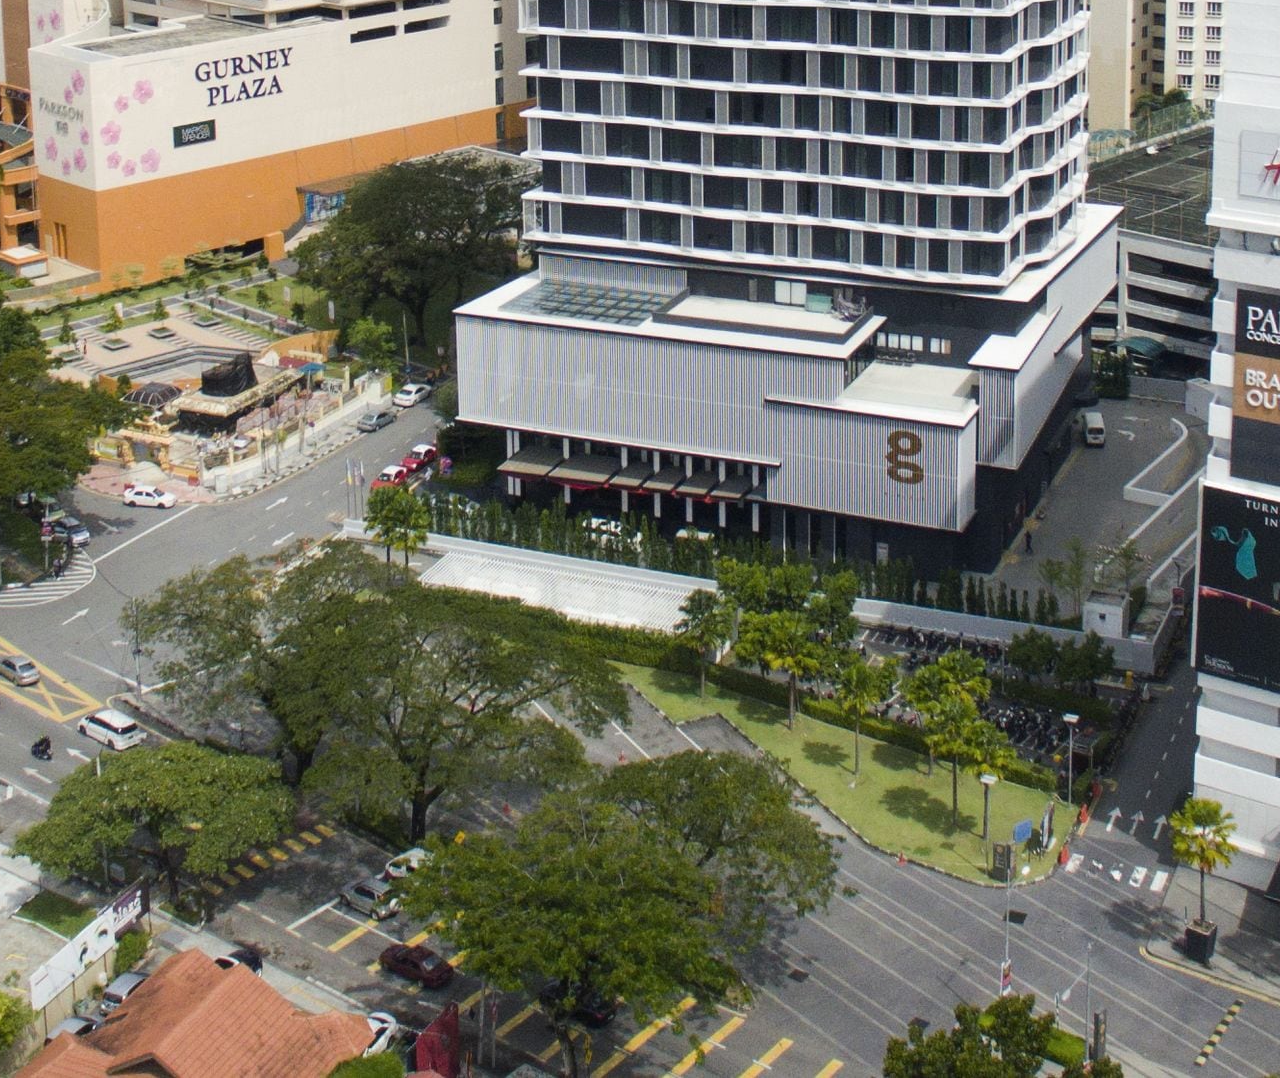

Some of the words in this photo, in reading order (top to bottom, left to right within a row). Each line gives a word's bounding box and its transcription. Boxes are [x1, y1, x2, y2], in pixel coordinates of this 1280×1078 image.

[194, 47, 293, 82] GURNEY
[207, 75, 283, 107] PLAZA
[1244, 499, 1280, 516] TURN
